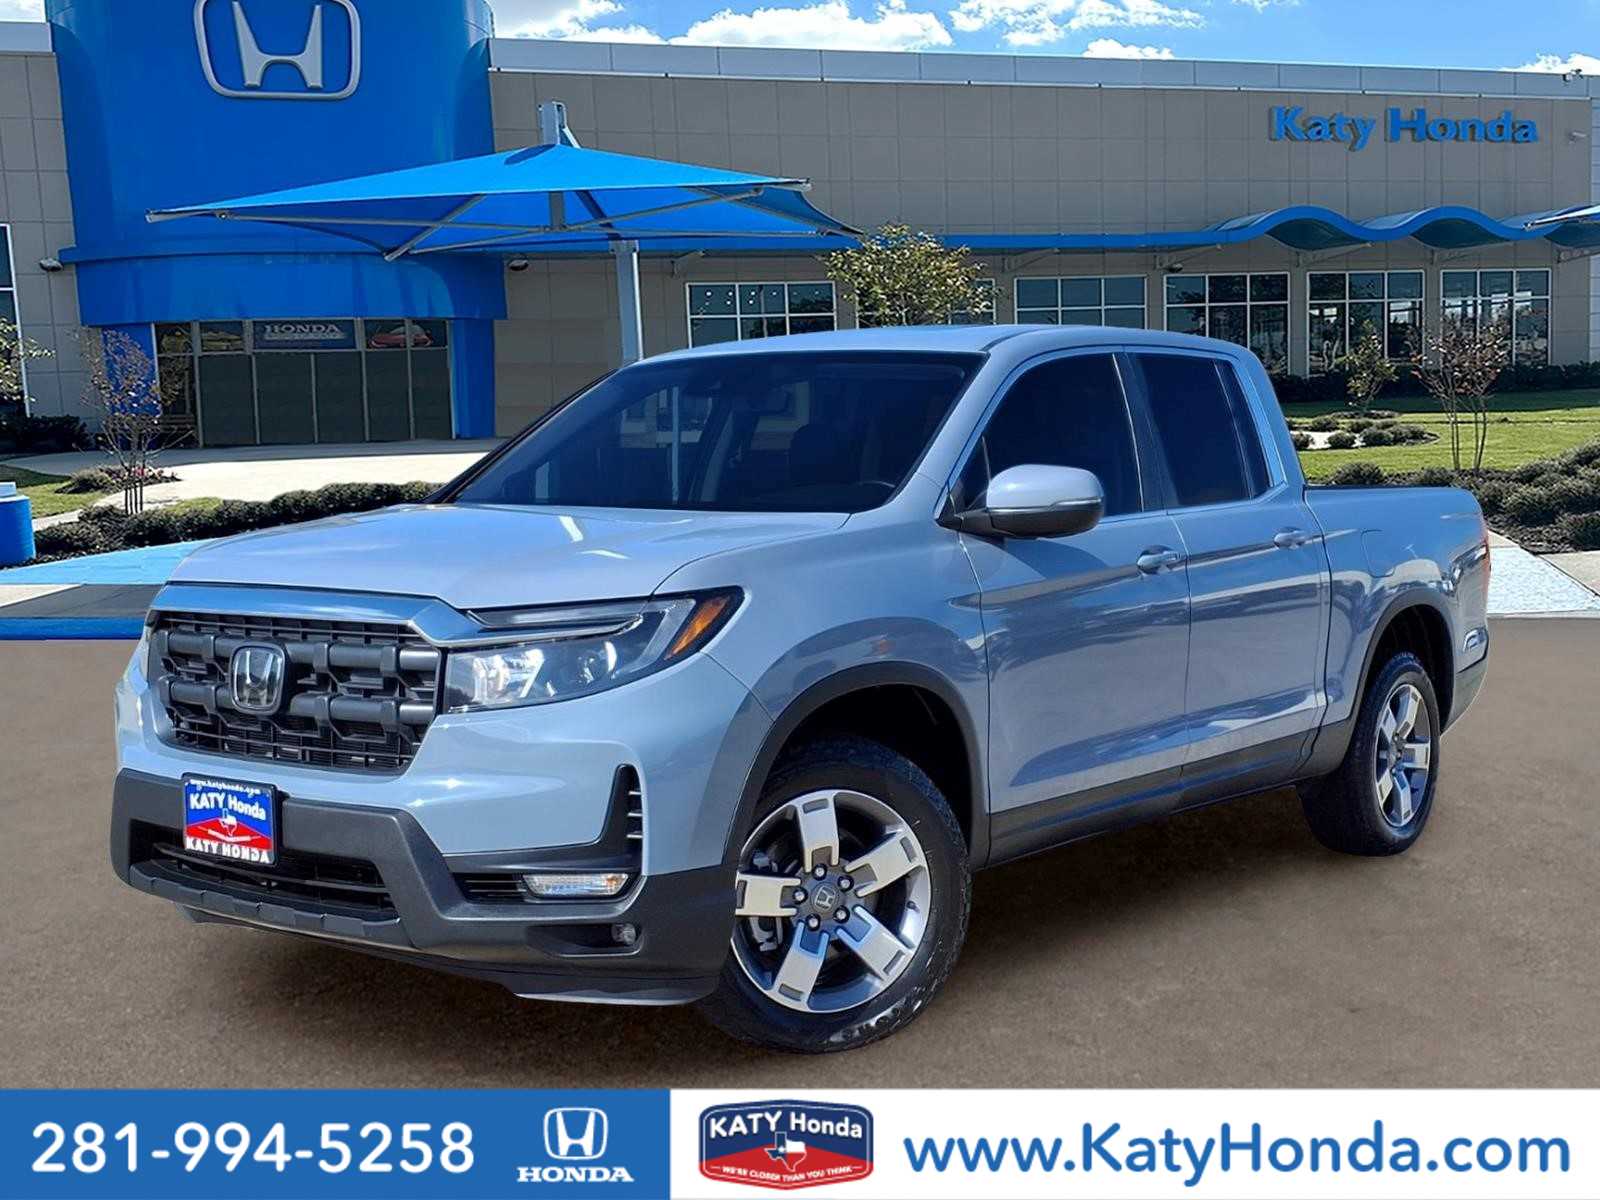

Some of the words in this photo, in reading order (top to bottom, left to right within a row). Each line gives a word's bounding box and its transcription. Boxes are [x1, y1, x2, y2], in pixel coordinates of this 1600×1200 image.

[1269, 105, 1376, 151] Katy
[1385, 107, 1539, 143] Honda
[264, 324, 339, 333] HONDA
[190, 793, 226, 809] KATY
[228, 794, 267, 821] Honda
[186, 836, 219, 854] KATY
[222, 843, 270, 864] HONDA
